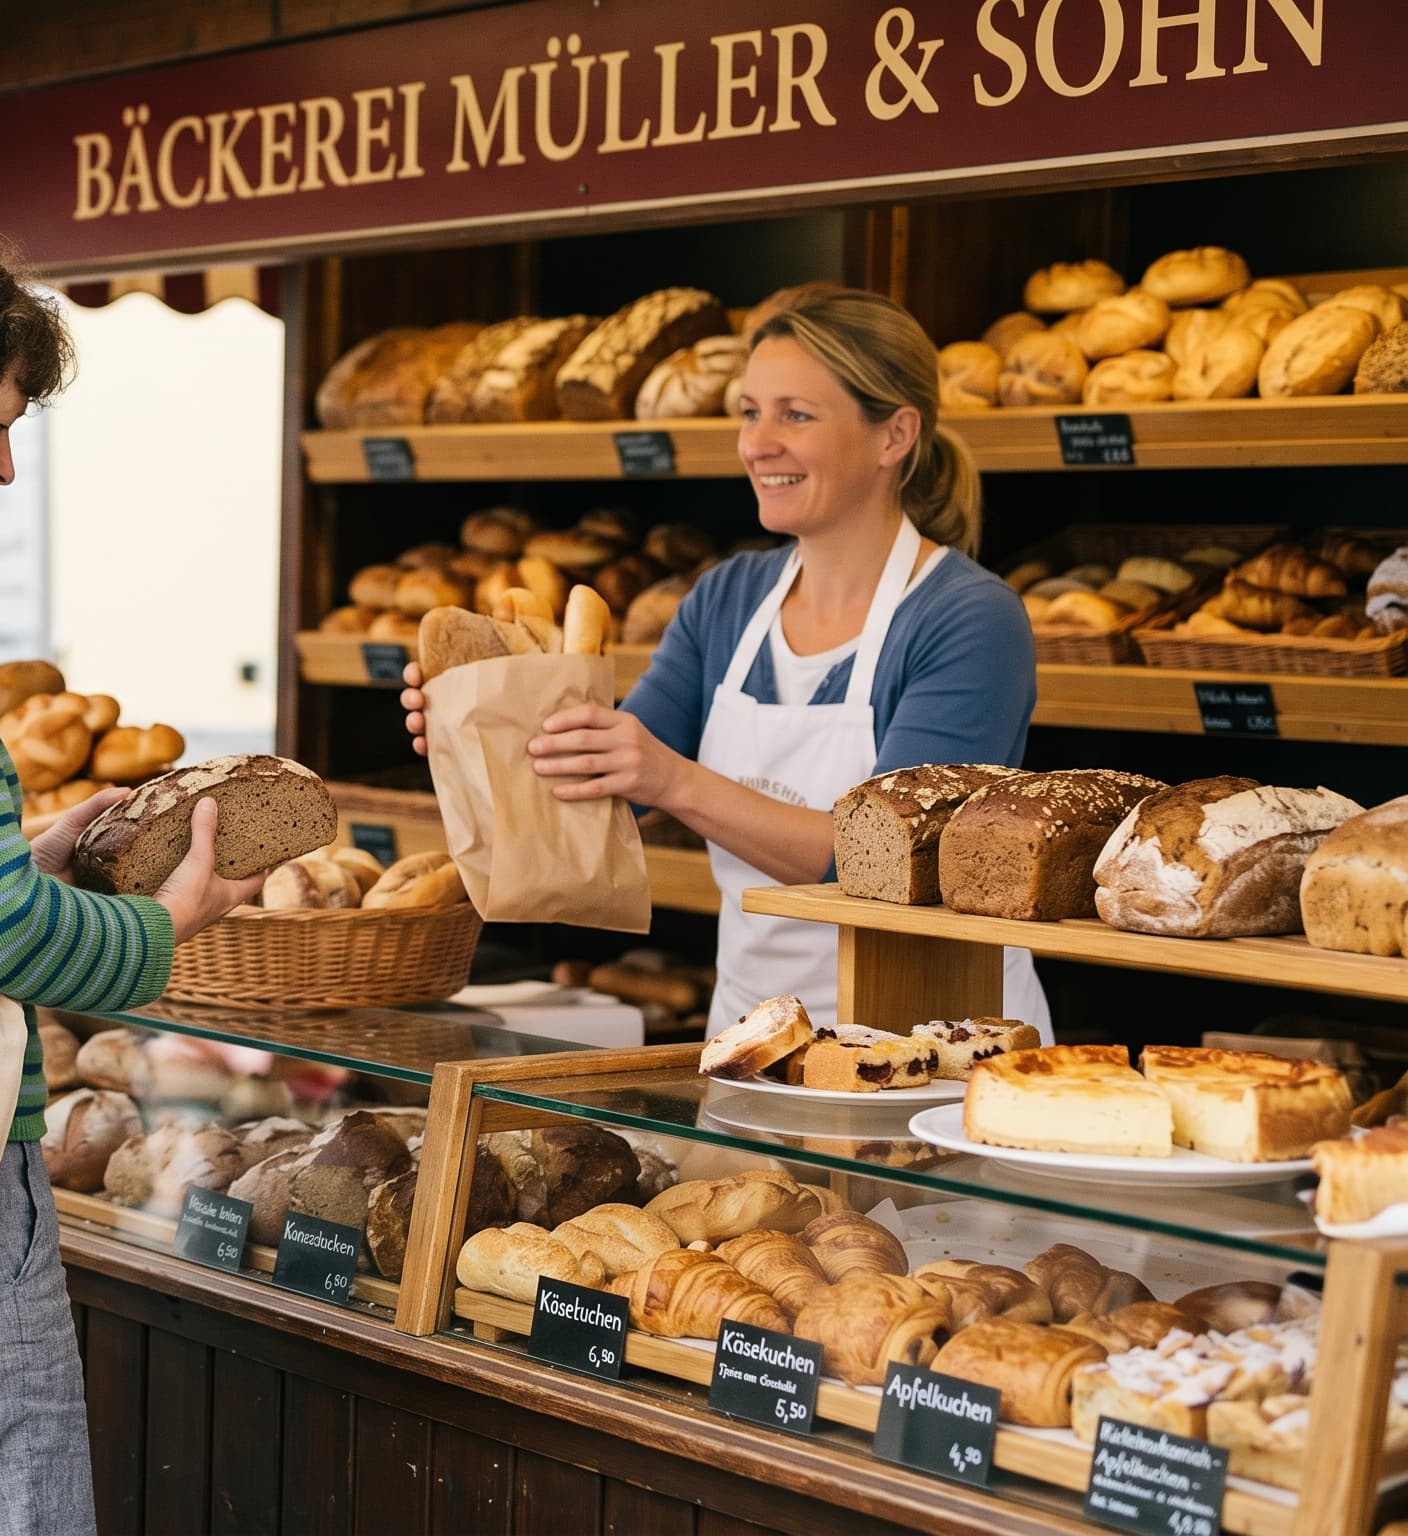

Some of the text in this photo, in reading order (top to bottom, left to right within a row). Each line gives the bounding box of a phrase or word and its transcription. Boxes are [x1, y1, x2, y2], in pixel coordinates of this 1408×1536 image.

[73, 82, 426, 221] BÄCKEREI
[445, 23, 837, 173] MÜLLER
[864, 7, 945, 121] &
[324, 1272, 349, 1296] 6,80
[721, 1329, 816, 1376] Käsekuchen
[774, 1398, 808, 1424] 5,50
[886, 1373, 993, 1425] Apfelkuchen
